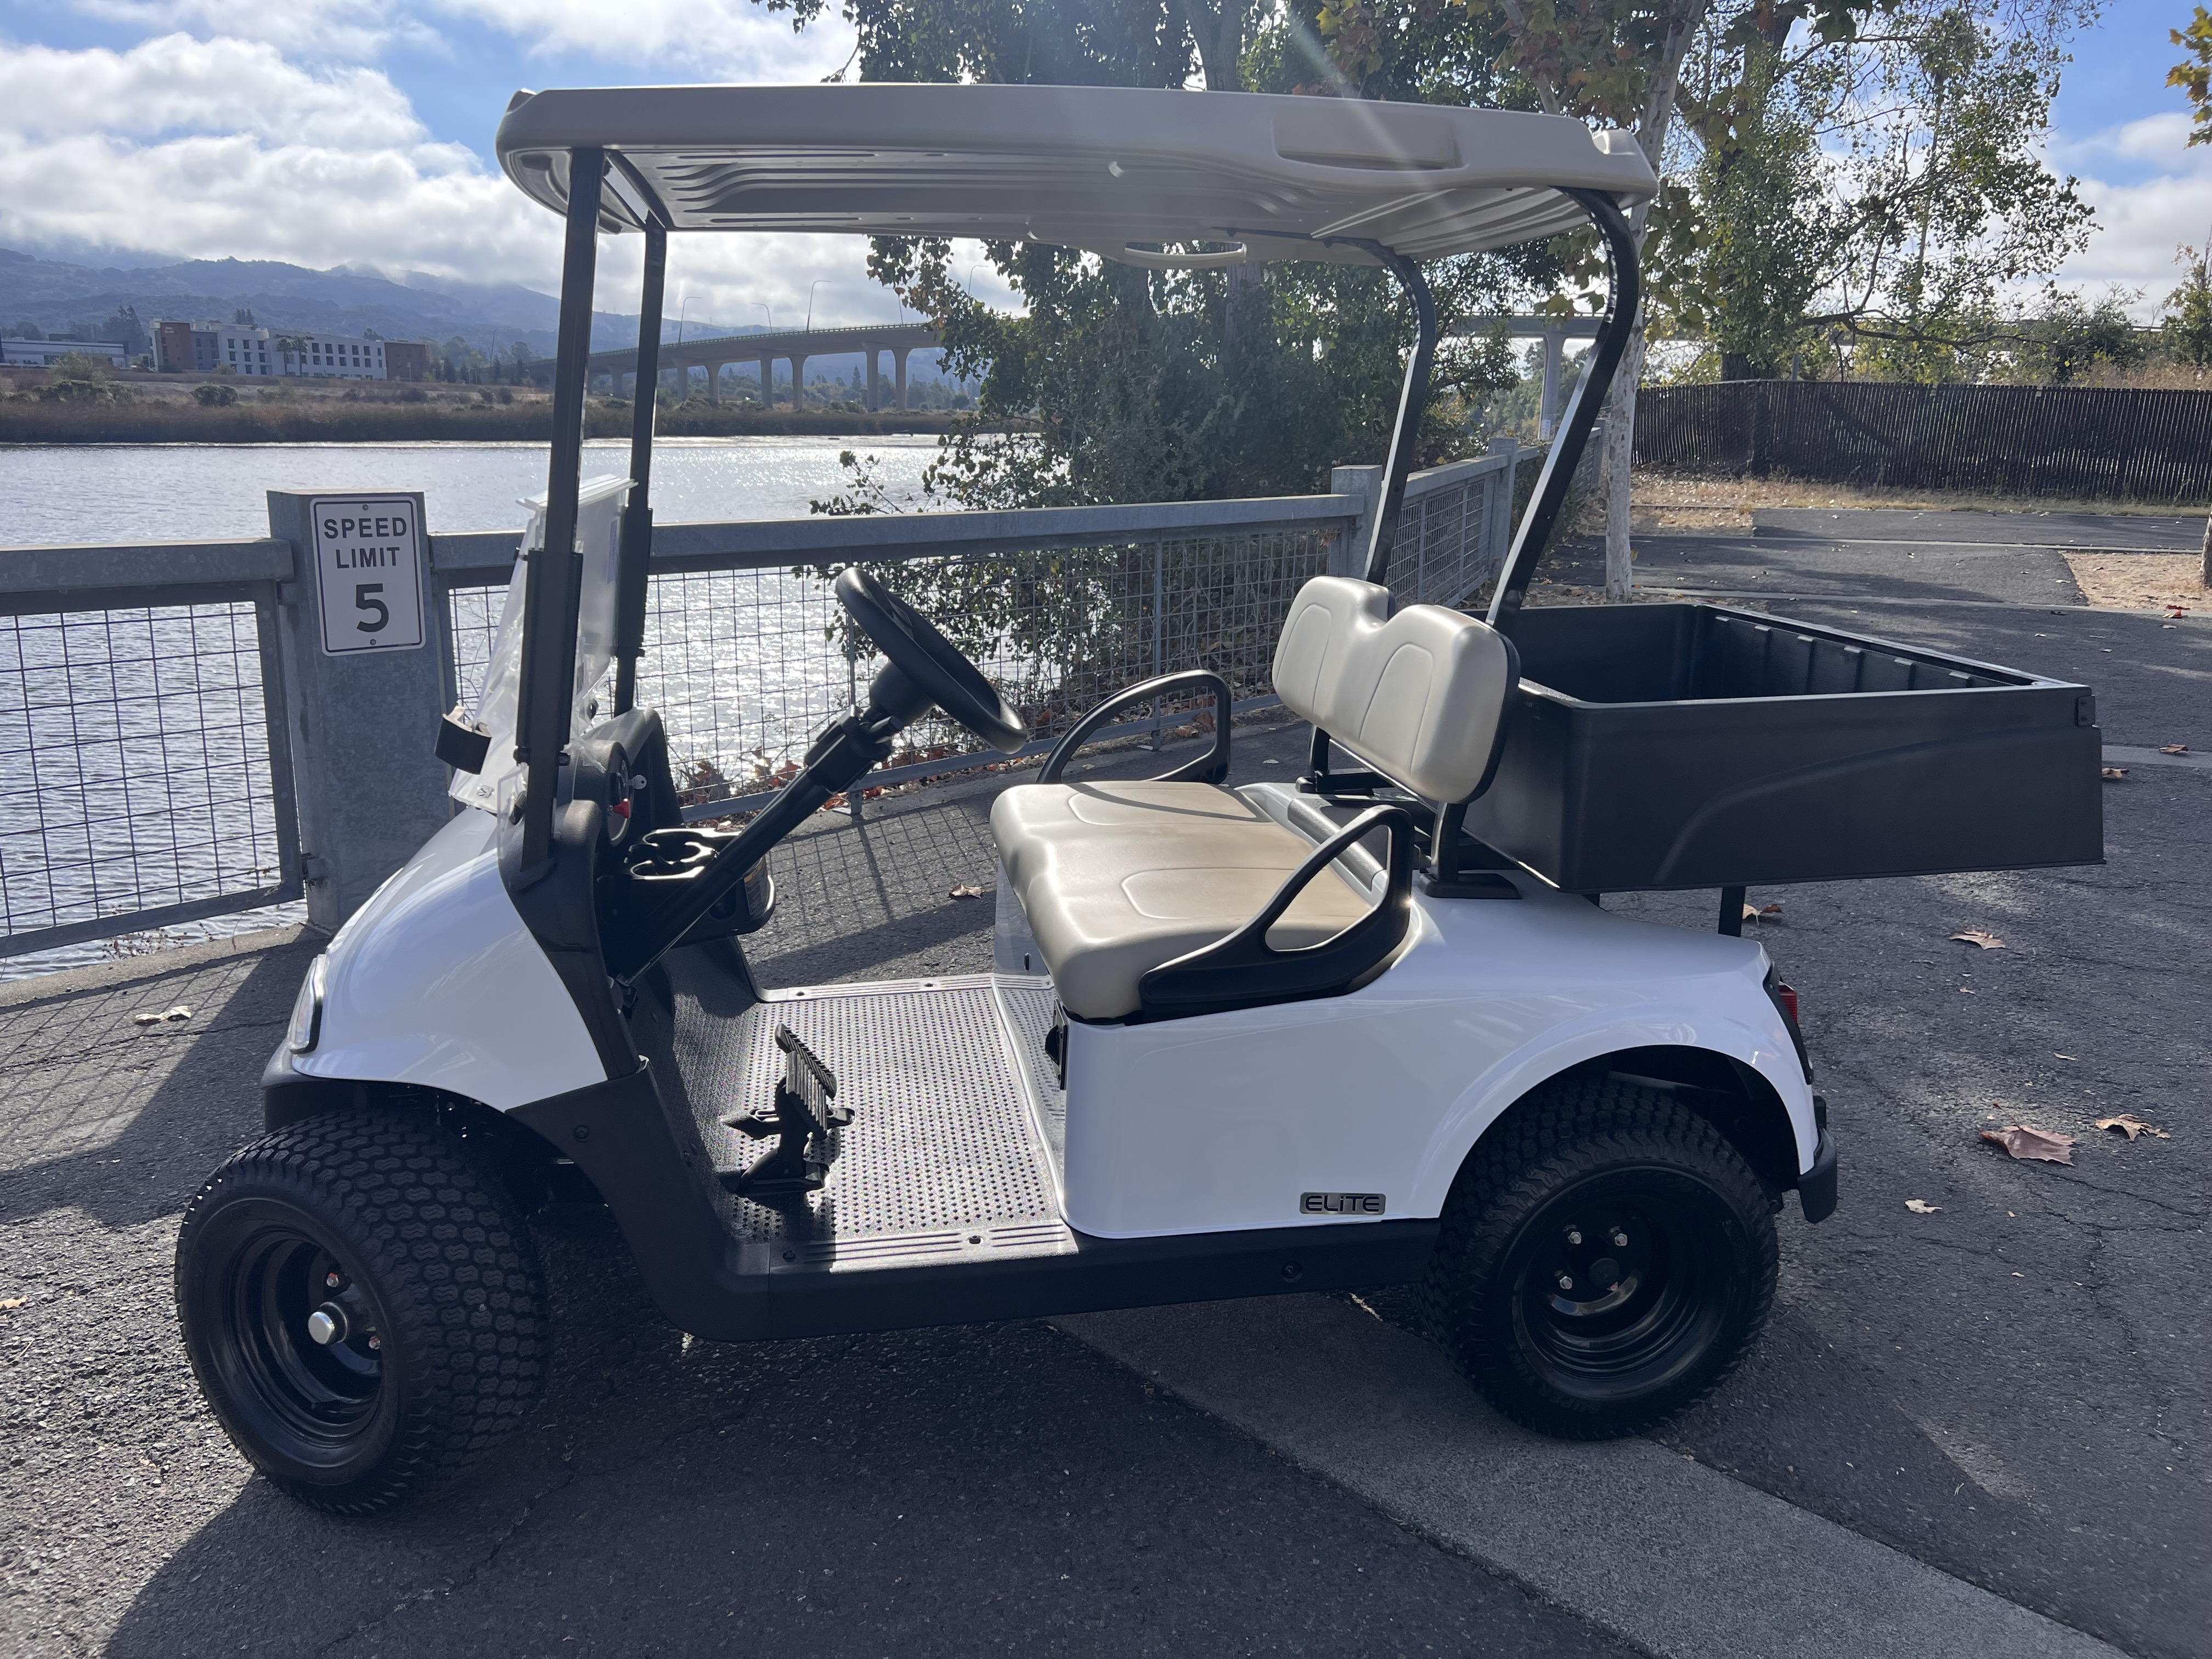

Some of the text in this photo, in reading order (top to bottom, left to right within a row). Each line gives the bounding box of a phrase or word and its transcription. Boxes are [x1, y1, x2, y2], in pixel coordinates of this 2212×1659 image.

[324, 517, 407, 539] SPEED
[336, 547, 400, 568] LIMIT
[356, 583, 389, 633] 5
